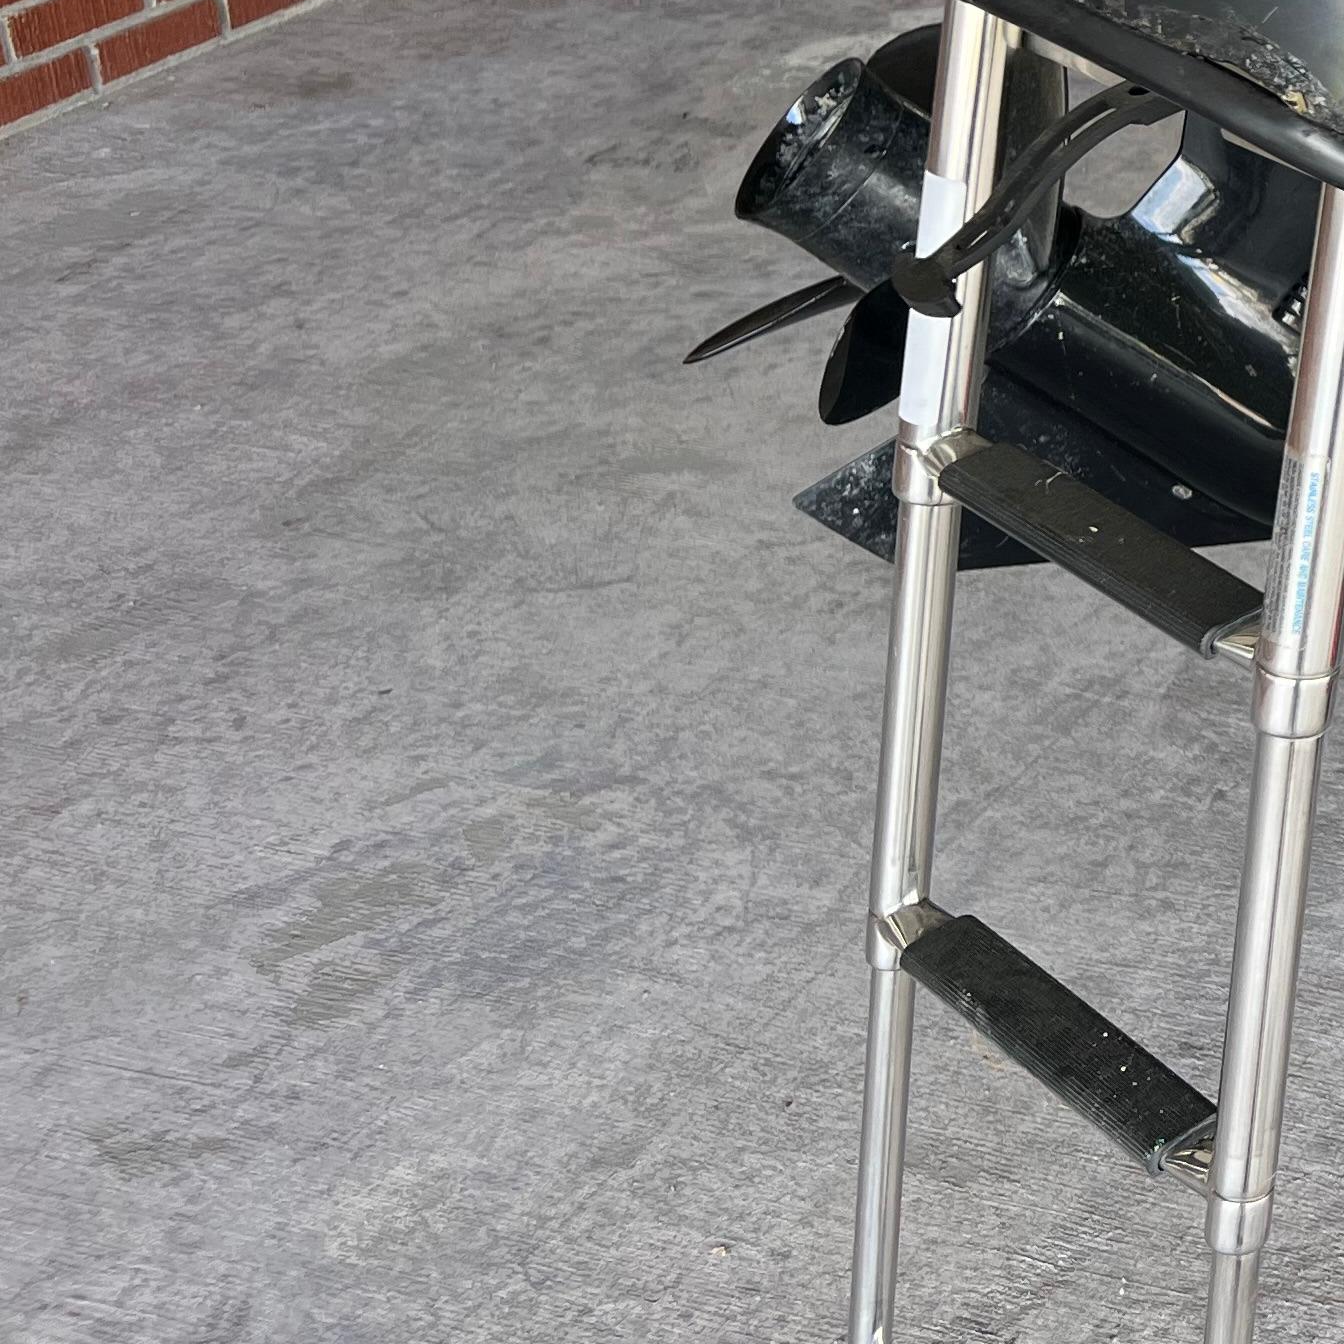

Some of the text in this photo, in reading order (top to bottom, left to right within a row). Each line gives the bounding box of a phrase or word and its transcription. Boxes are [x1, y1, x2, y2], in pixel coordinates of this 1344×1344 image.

[1306, 472, 1320, 514] STAINLESS
[1304, 515, 1314, 538] STEEL
[1292, 582, 1308, 635] MAINTENANCE
